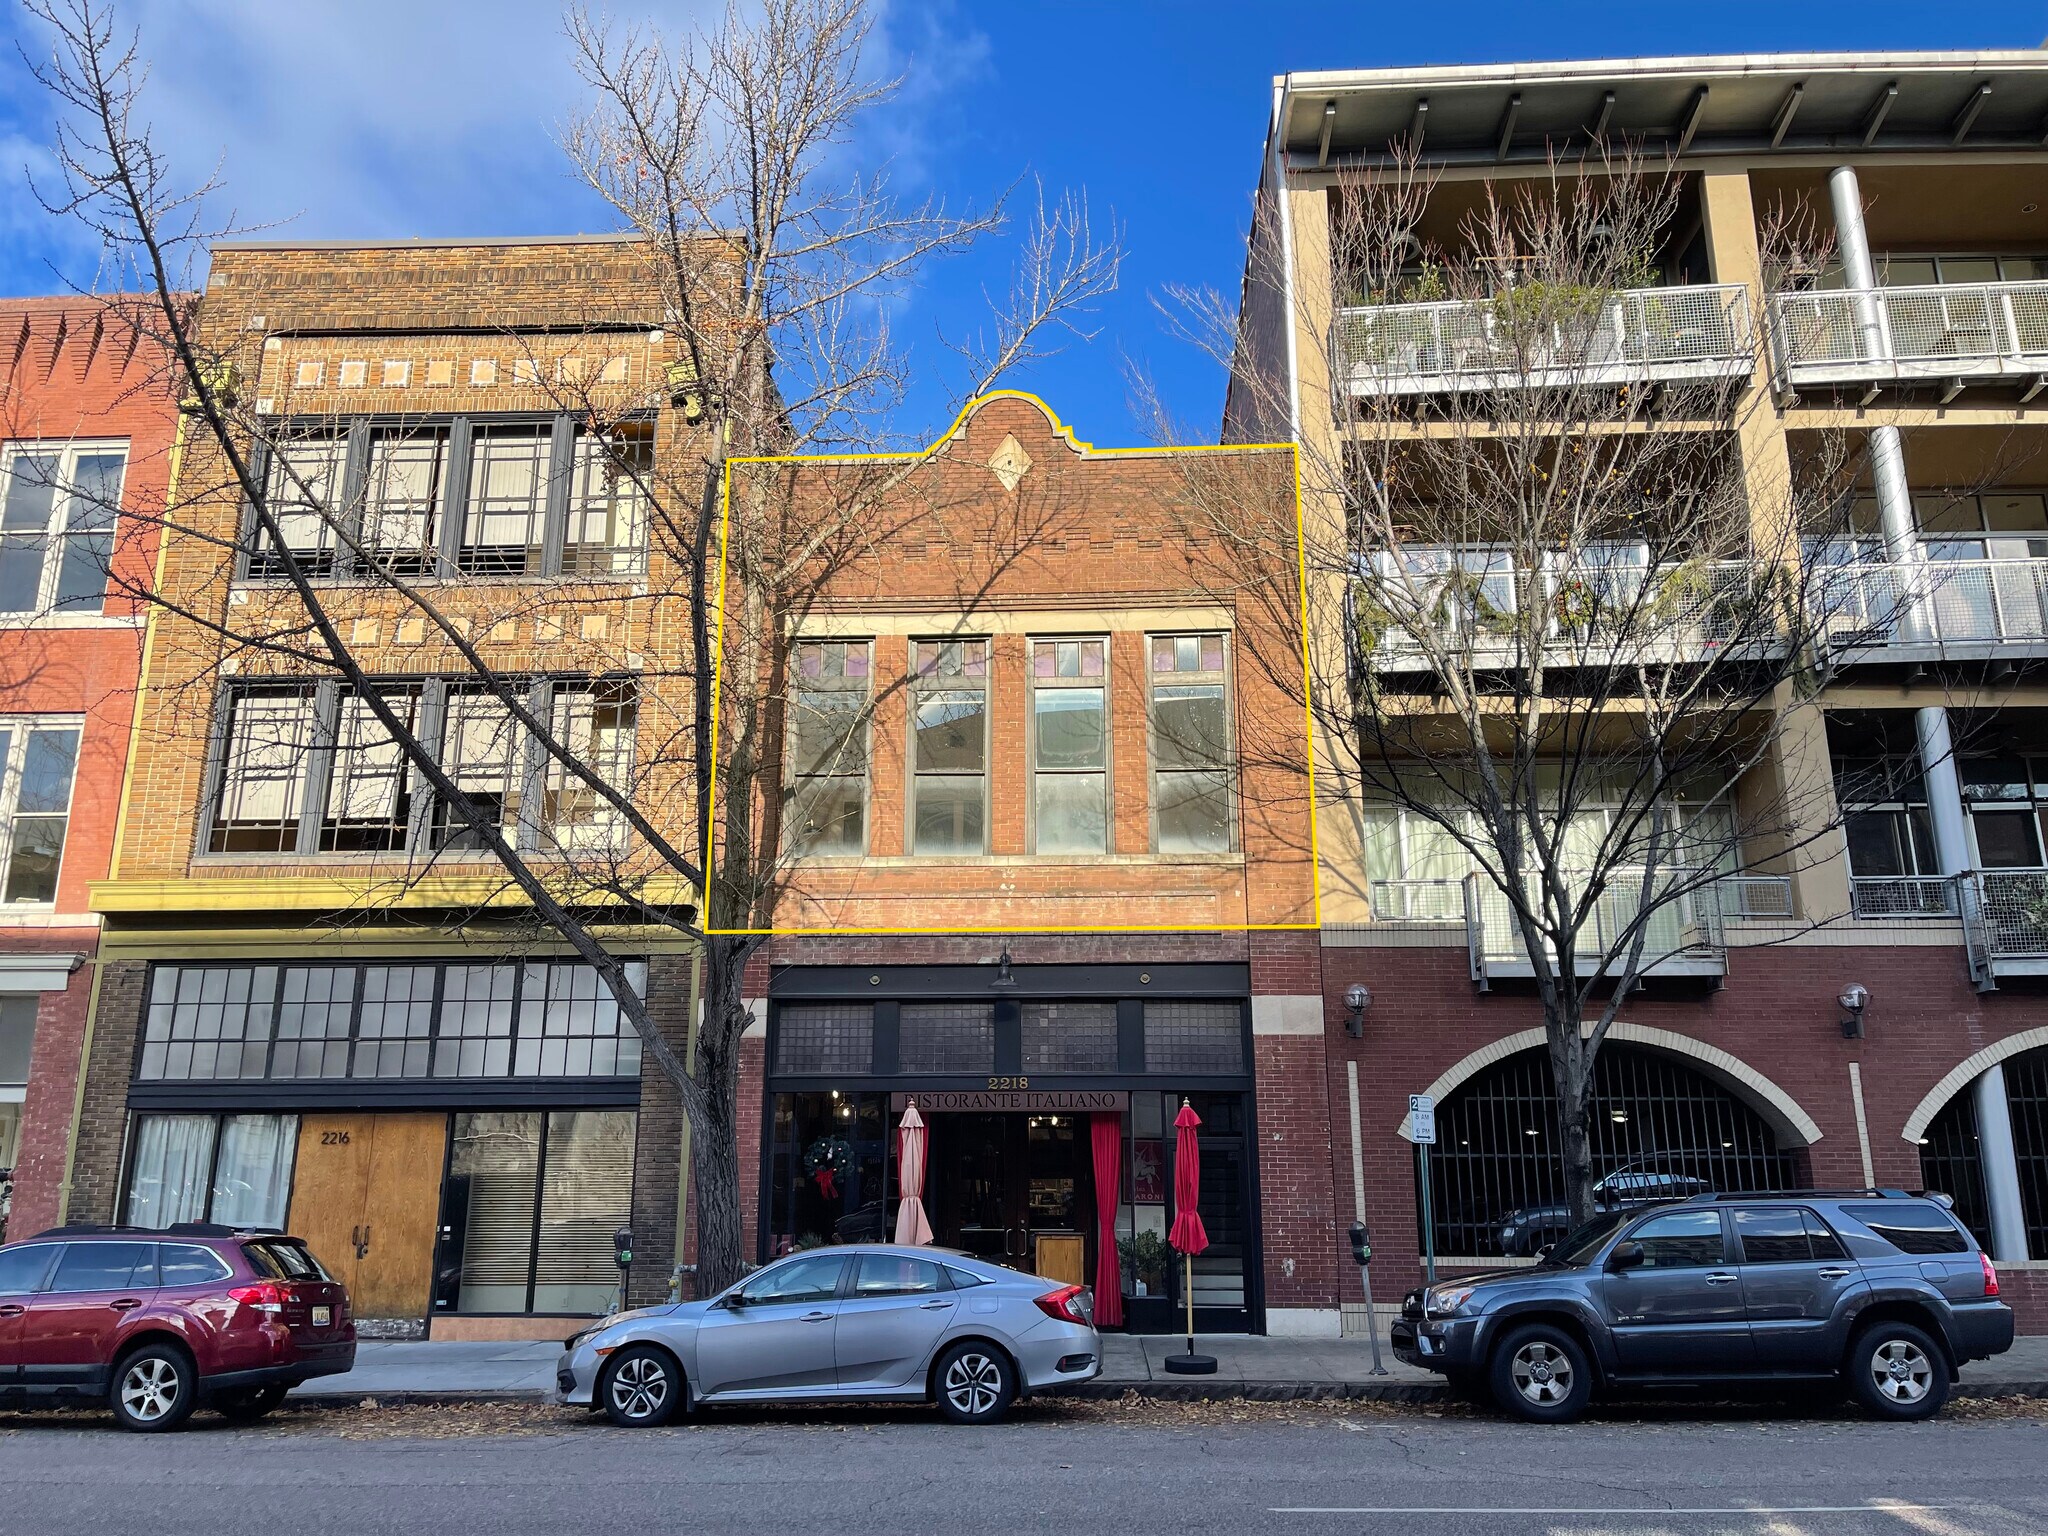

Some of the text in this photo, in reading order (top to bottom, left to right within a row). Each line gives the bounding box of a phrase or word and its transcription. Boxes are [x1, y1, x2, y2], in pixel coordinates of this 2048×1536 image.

[988, 1077, 1029, 1090] 2218
[1026, 1093, 1116, 1108] ITALIANO
[1411, 1098, 1418, 1109] 2
[321, 1131, 350, 1145] 2216
